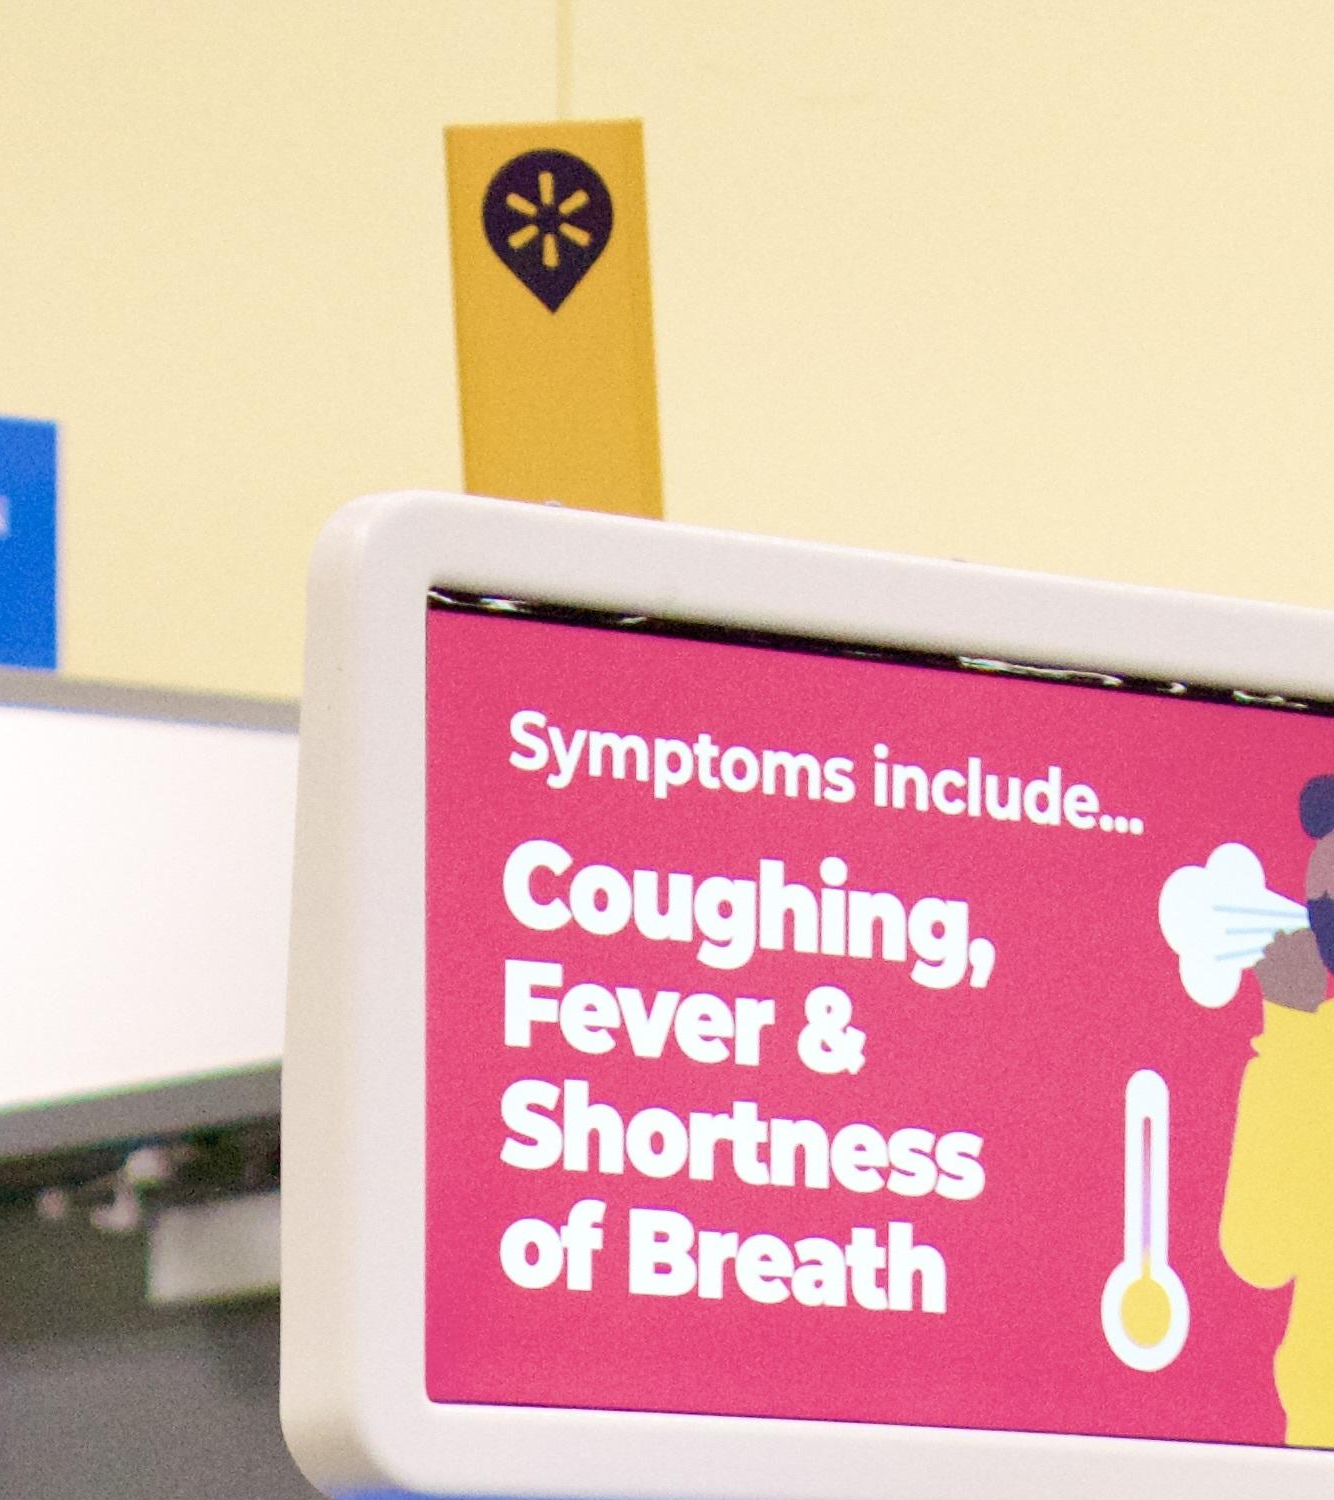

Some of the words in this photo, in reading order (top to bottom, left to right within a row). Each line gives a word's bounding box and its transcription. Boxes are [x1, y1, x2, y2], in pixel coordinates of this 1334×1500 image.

[509, 709, 855, 801] Symptoms
[873, 743, 1144, 834] include...
[503, 838, 996, 989] Coughing,
[504, 958, 775, 1066] Fever
[797, 985, 866, 1074] &
[500, 1078, 986, 1199] Shortness
[500, 1198, 606, 1291] of
[628, 1207, 947, 1314] Breath
